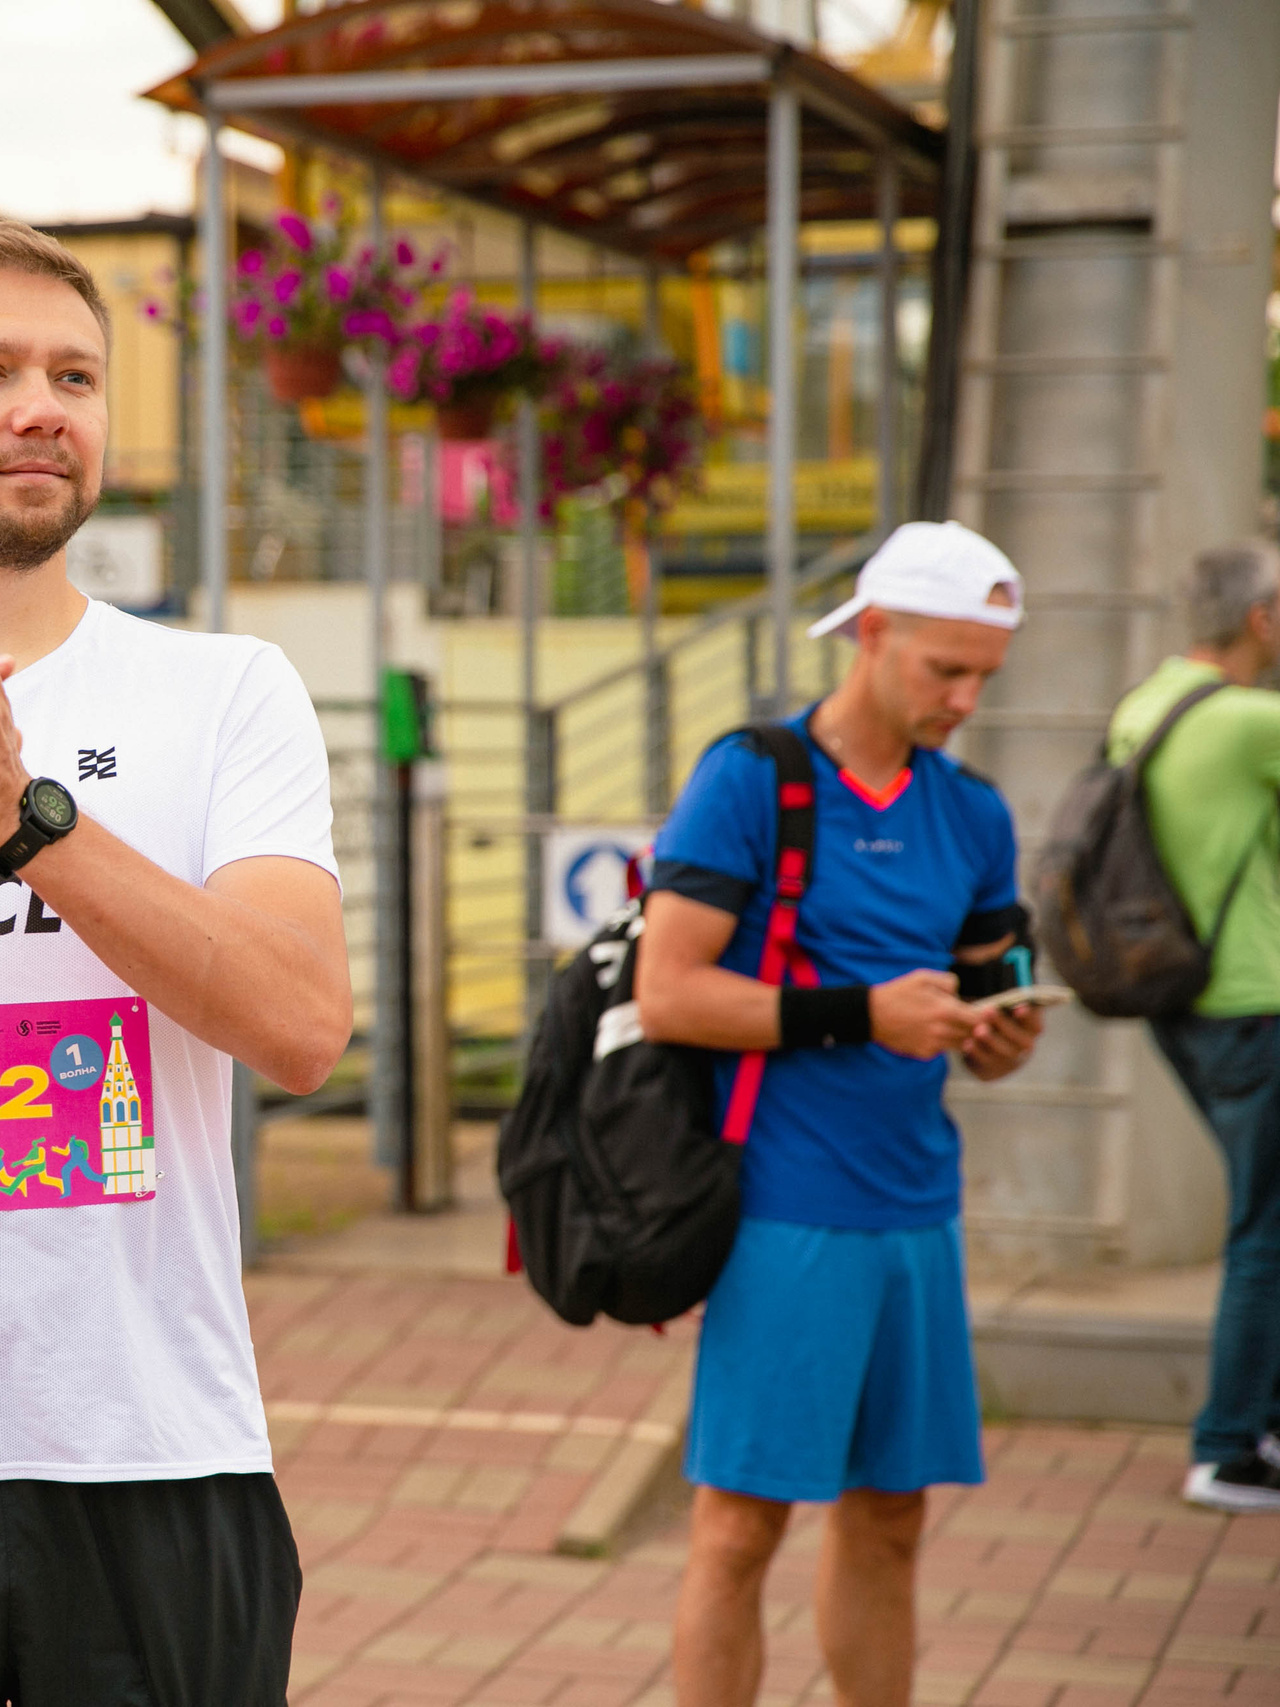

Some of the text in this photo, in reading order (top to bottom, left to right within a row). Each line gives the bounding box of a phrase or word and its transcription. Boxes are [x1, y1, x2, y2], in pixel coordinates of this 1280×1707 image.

[48, 795, 67, 815] 26
[65, 1043, 82, 1066] 1
[59, 1065, 97, 1080] ВОЛНА
